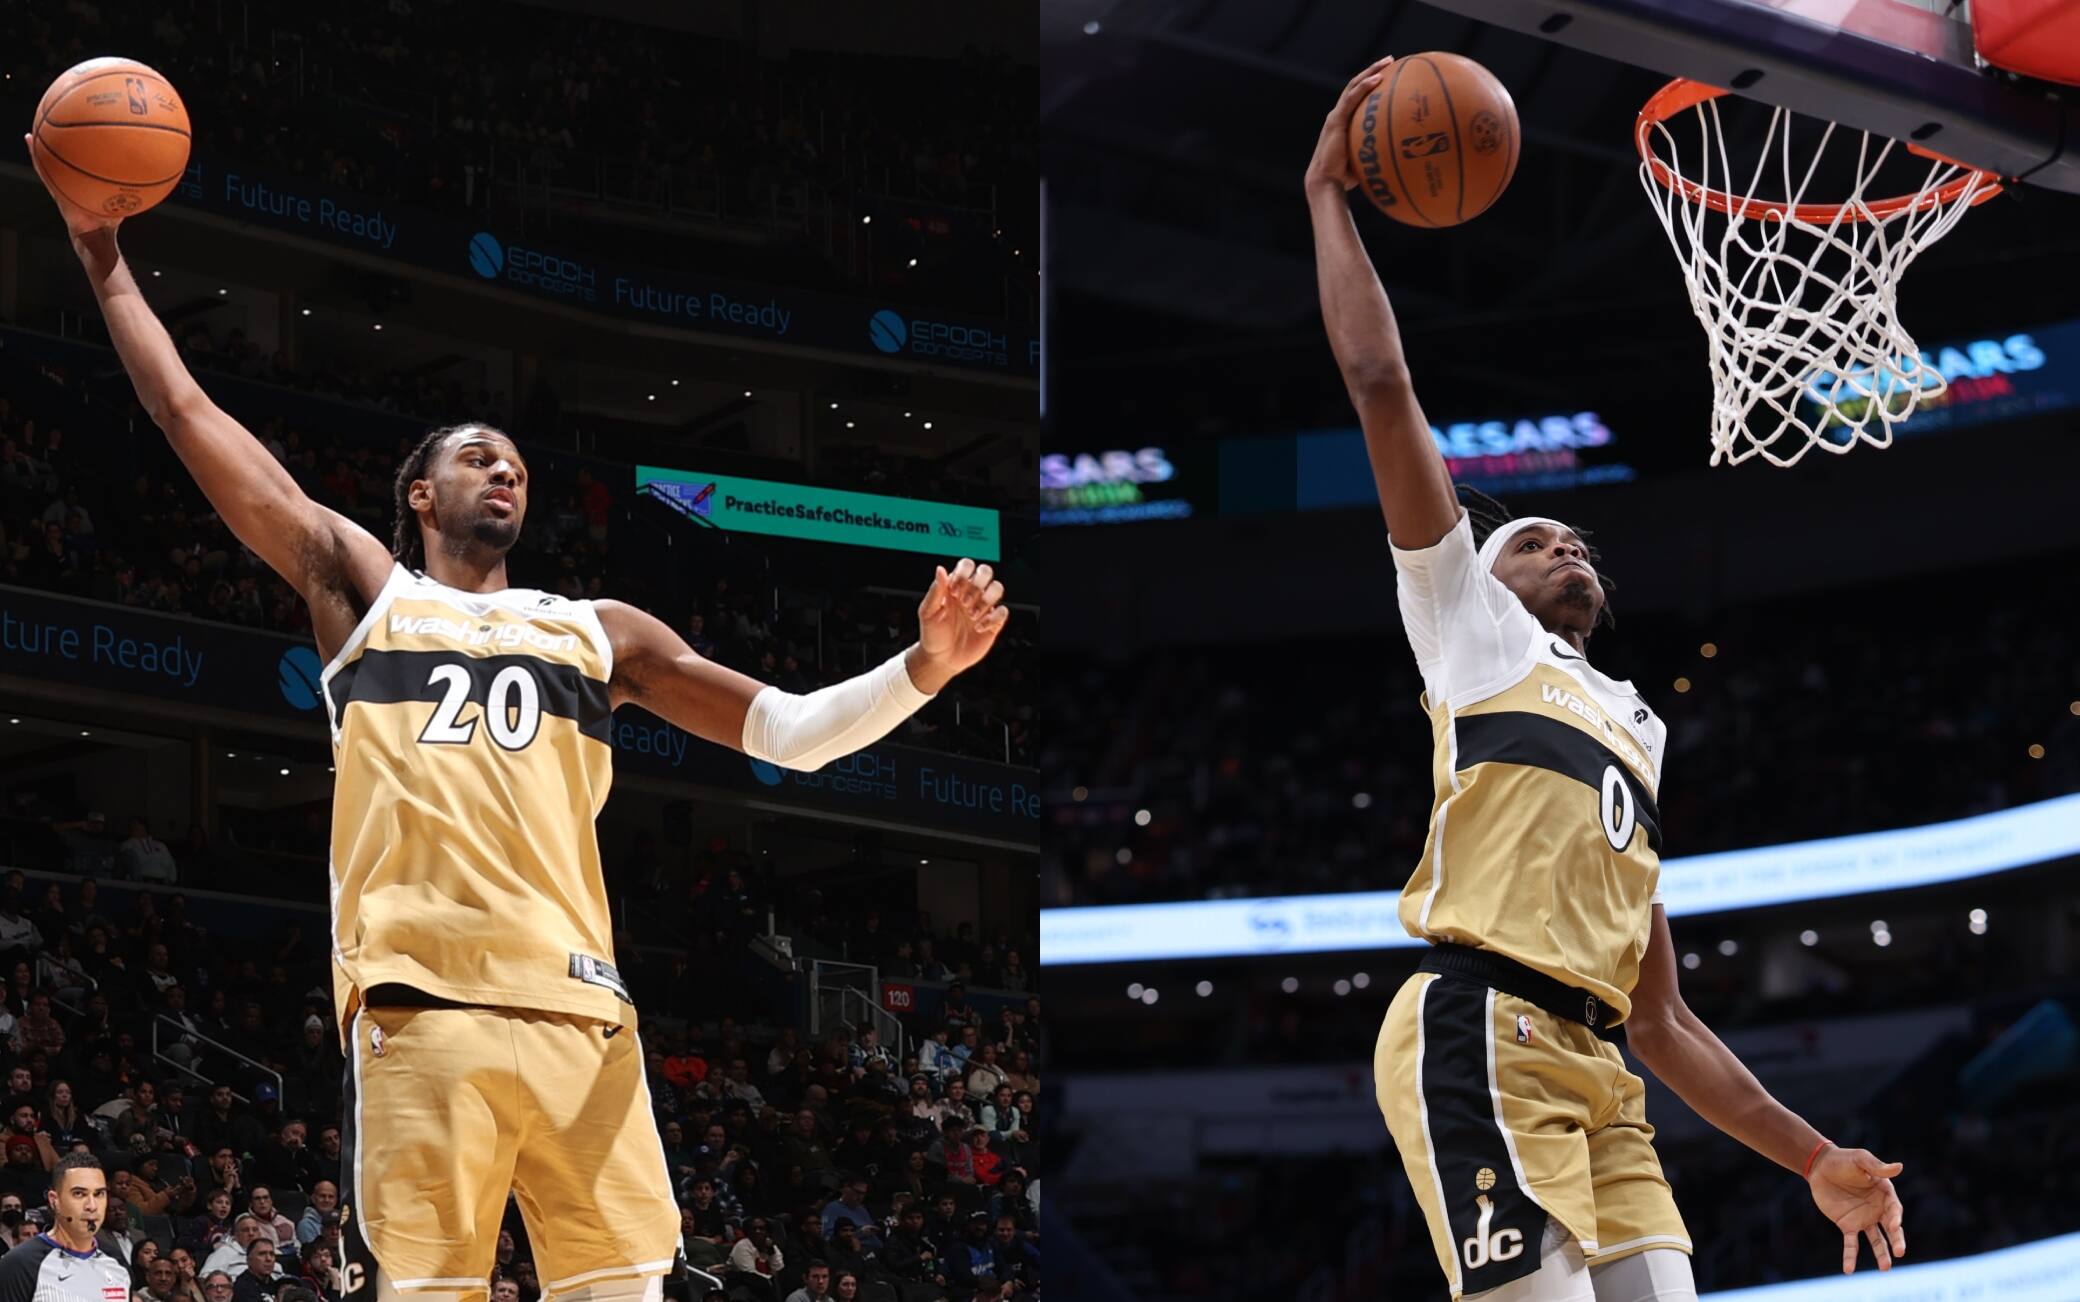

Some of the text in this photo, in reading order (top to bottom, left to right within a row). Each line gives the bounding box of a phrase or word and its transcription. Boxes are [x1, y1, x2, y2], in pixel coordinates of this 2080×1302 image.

[225, 173, 398, 249] Future Ready
[508, 245, 597, 289] EPOCH
[614, 277, 792, 336] Future Ready
[911, 319, 1008, 352] EPOCH
[1430, 411, 1612, 458] ESARS
[725, 495, 931, 535] PracticeSafeChecks.com
[92, 623, 204, 687] Ready
[390, 613, 578, 652] washington
[416, 663, 542, 752] 20
[835, 752, 897, 781] OCH
[919, 766, 1004, 813] Future
[1599, 763, 1638, 853] 0
[887, 990, 911, 1008] 120
